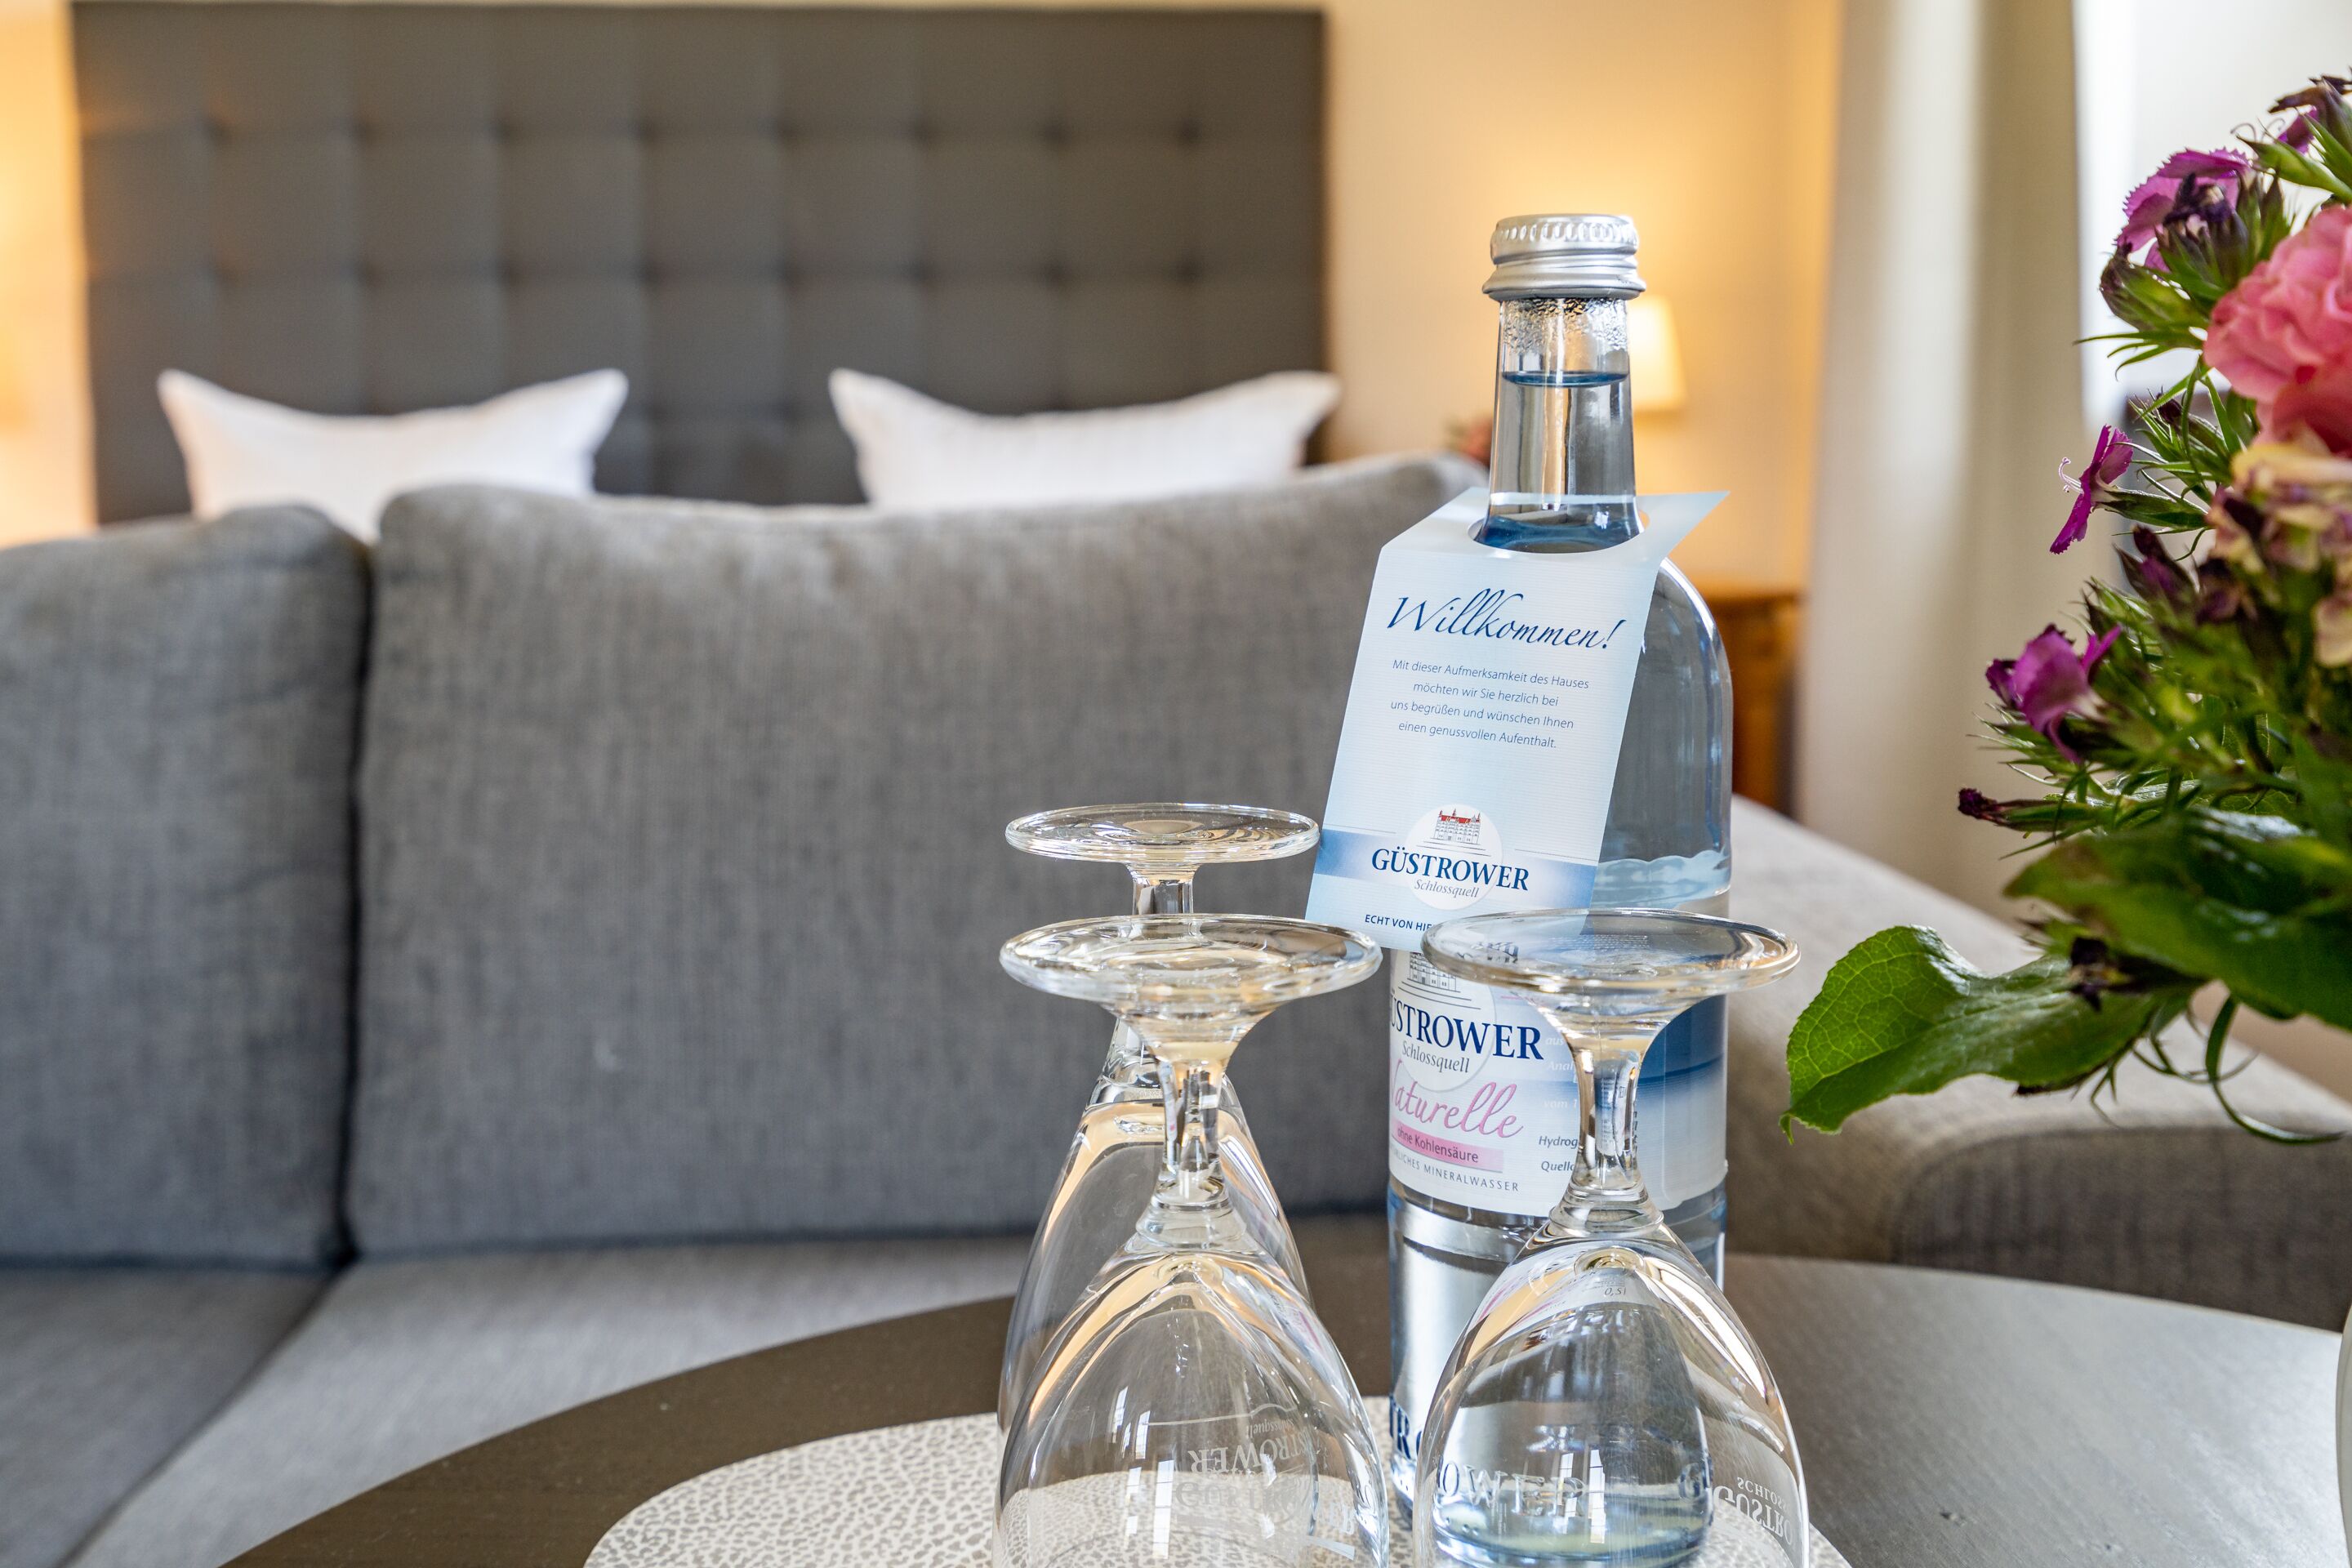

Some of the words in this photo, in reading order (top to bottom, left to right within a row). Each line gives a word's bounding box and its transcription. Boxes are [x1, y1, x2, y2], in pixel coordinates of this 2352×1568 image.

[1387, 588, 1627, 649] Willkommen!
[1392, 659, 1410, 671] Mit
[1411, 661, 1442, 674] dieser
[1444, 664, 1528, 683] Aufmerksamkeit
[1530, 673, 1548, 685] des
[1552, 675, 1589, 689] Hauses
[1413, 682, 1459, 696] möchten
[1462, 686, 1478, 697] wir
[1480, 688, 1496, 700] Sie
[1499, 689, 1539, 706] herzlich
[1542, 694, 1559, 707] bei
[1391, 702, 1409, 711] uns
[1411, 702, 1460, 718] begrüßen
[1463, 707, 1484, 719] und
[1486, 710, 1540, 726] wünschen
[1543, 715, 1575, 729] Ihnen
[1398, 721, 1427, 733] einen
[1429, 725, 1497, 742] genussvollen
[1499, 732, 1557, 749] Aufenthalt.
[1371, 846, 1530, 891] GÜSTROWER
[1414, 879, 1480, 898] Schlossquell
[1365, 914, 1390, 926] ECHT
[1392, 918, 1414, 929] VON
[1390, 988, 1545, 1060] ÜSTROWER
[1402, 1040, 1470, 1073] Schlossquell
[1546, 1061, 1575, 1071] Anal
[1397, 1127, 1413, 1144] ohne
[1414, 1134, 1479, 1164] Kohlensäure
[1539, 1135, 1579, 1150] Hydrog
[1423, 1163, 1519, 1192] MINERALWASSER
